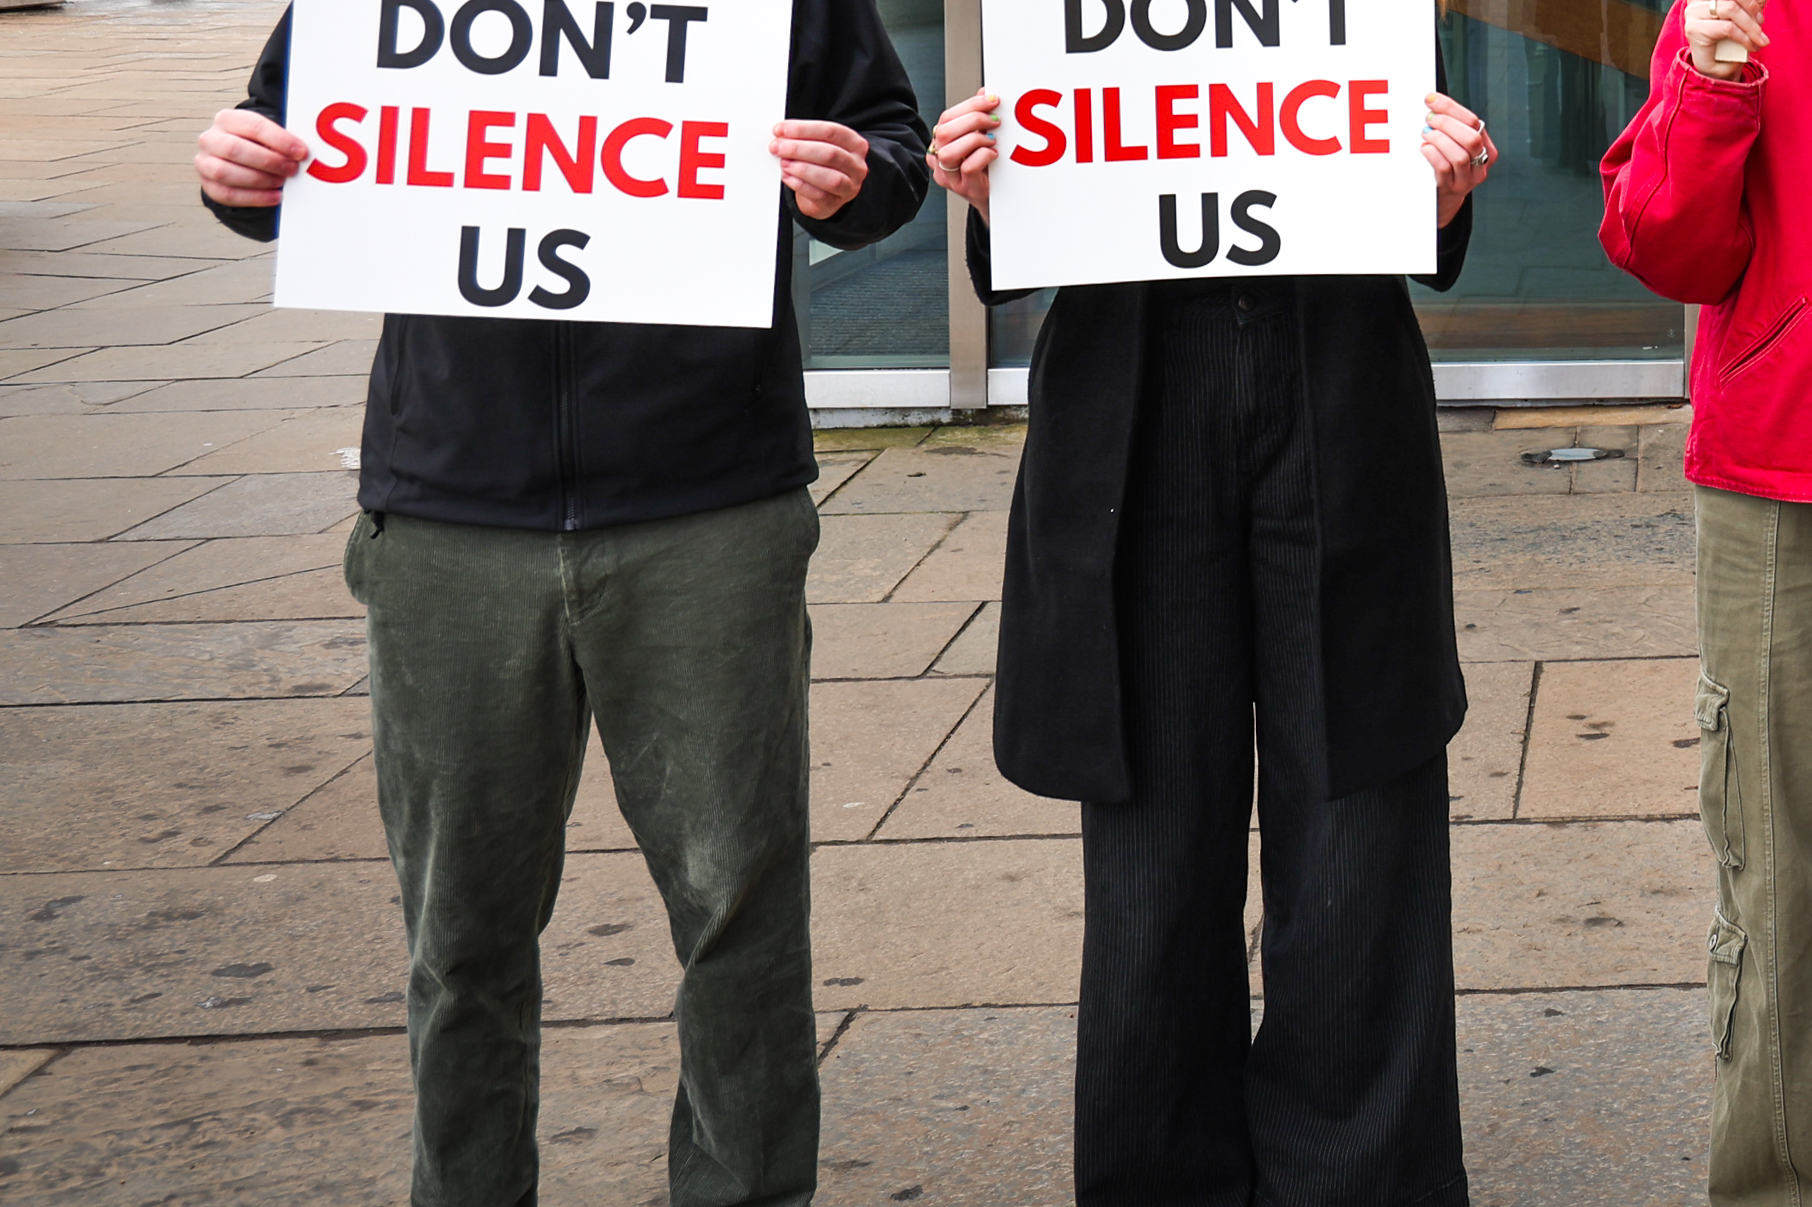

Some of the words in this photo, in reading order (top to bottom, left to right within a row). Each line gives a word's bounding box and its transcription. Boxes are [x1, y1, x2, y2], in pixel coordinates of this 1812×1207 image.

[306, 101, 729, 200] SILENCE
[1010, 79, 1391, 168] SILENCE
[457, 225, 591, 310] US
[1158, 189, 1281, 269] US
